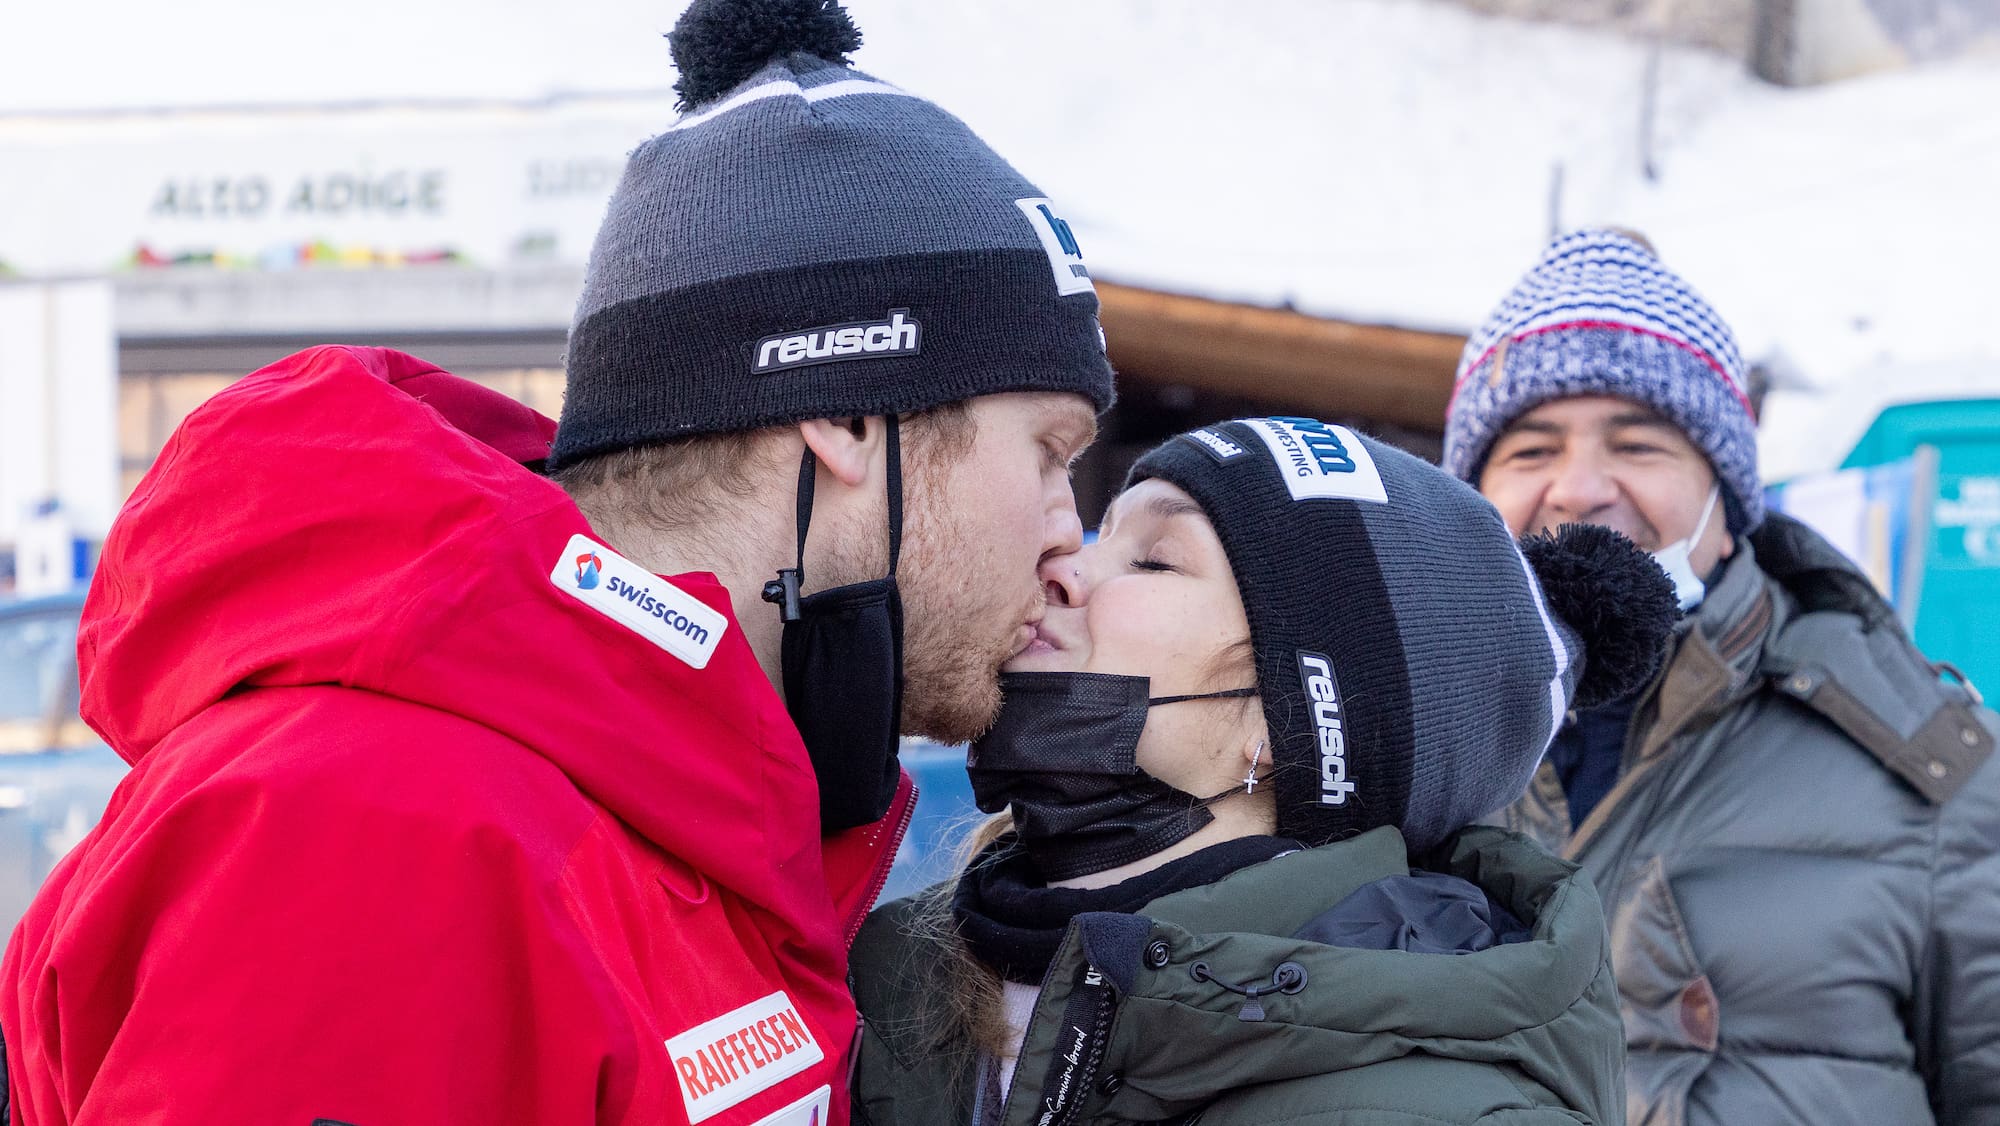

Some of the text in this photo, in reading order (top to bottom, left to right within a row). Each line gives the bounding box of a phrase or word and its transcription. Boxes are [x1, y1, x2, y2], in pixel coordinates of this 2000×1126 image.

[757, 313, 917, 368] reusch
[606, 575, 709, 645] swisscom
[1302, 656, 1355, 805] reusch
[676, 1008, 811, 1101] RAIFFEISEN
